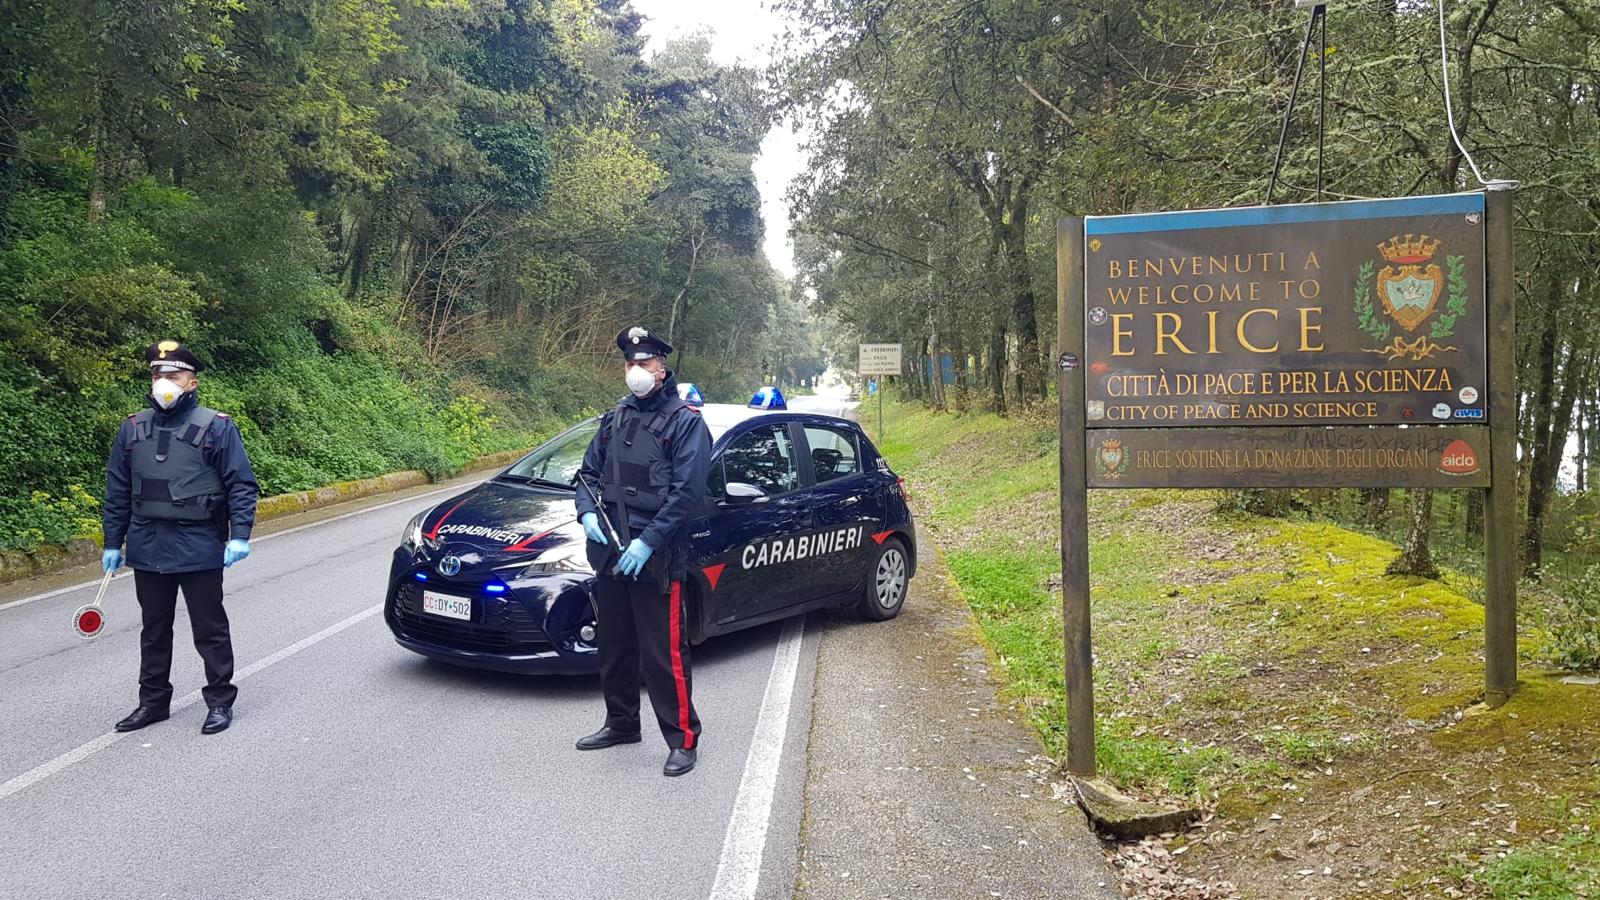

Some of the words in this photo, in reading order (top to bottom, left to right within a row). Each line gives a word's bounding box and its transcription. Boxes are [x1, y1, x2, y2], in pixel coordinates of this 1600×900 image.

[1108, 252, 1287, 279] BENVENUTI
[1303, 251, 1321, 269] A
[1106, 282, 1261, 305] WELCOME
[1278, 279, 1321, 300] TO
[1108, 306, 1325, 356] ERICE
[1106, 368, 1171, 397] CITTÀ
[1175, 374, 1199, 396] DI
[1204, 372, 1256, 396] PACE
[1260, 372, 1274, 395] E
[1278, 371, 1320, 395] PER
[1323, 370, 1350, 394] LA
[1354, 368, 1454, 393] SCIENZA
[1106, 405, 1150, 421] CITY
[1153, 404, 1179, 420] OF
[1183, 404, 1241, 420] PEACE
[1245, 403, 1289, 419] AND
[1293, 402, 1378, 418] SCIENCE
[1136, 450, 1171, 469] ERICE
[1175, 449, 1232, 469] SOSTIENE
[1234, 449, 1251, 468] LA
[1255, 449, 1332, 469] DONAZIONE
[1336, 449, 1373, 468] DEGLI
[1376, 448, 1429, 468] ORGANI
[1442, 453, 1475, 467] aido
[437, 524, 525, 546] CARABINIERI
[741, 526, 864, 570] CARABINIERI
